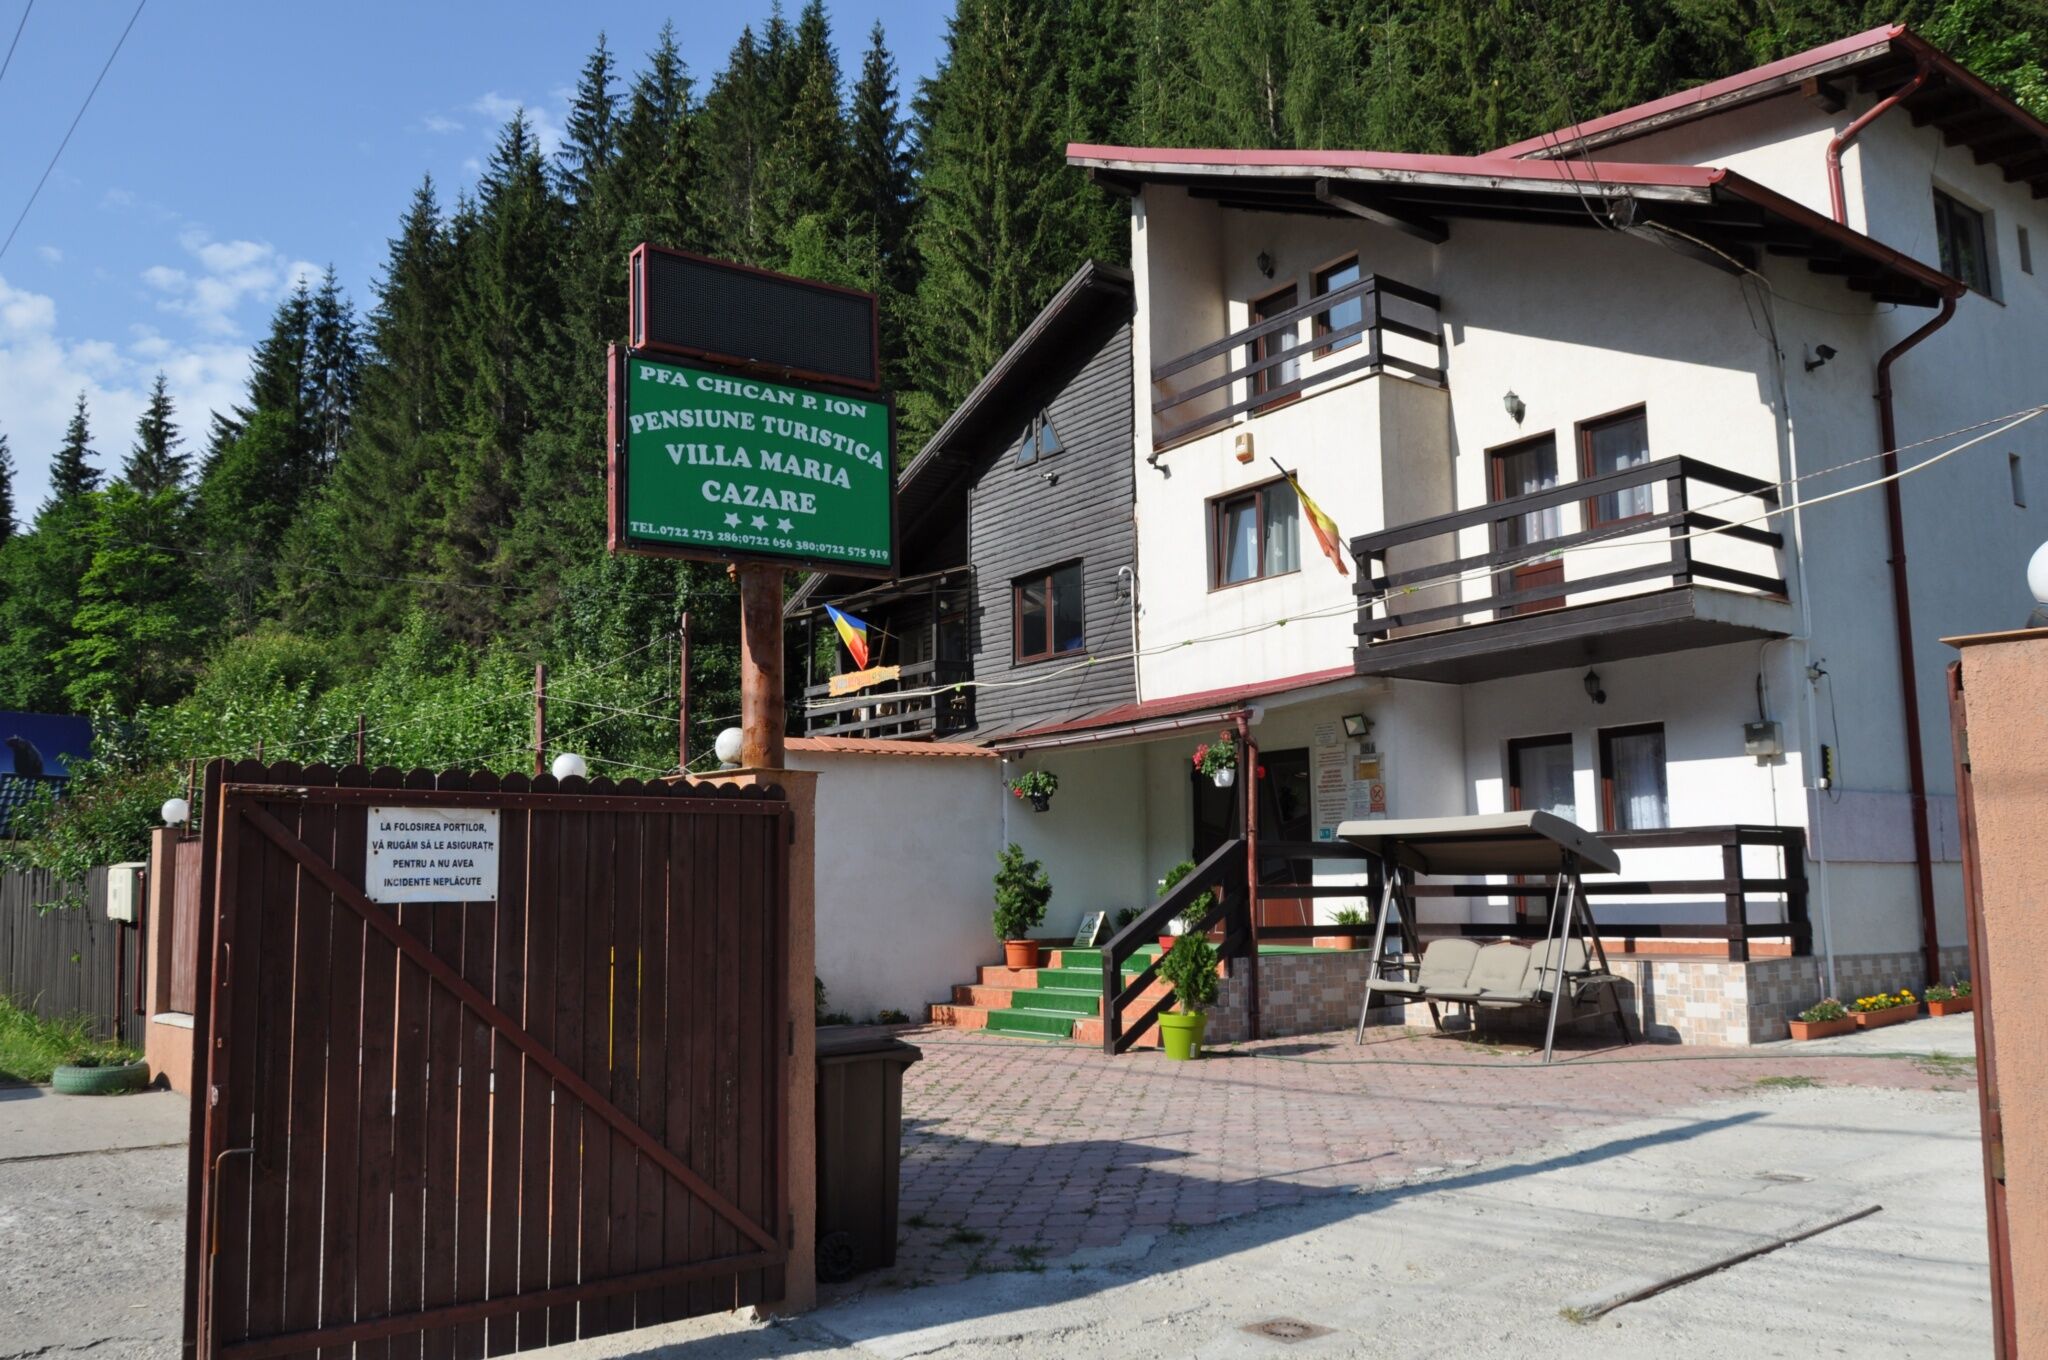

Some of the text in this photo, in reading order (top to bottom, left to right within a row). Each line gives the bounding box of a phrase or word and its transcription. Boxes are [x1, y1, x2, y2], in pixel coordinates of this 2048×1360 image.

[639, 366, 867, 418] PFA CHICAN P. ION
[629, 409, 884, 469] PENSIUNE TURISTICA
[666, 444, 851, 489] VILLA MARIA
[701, 480, 817, 515] CAZARE
[630, 521, 689, 537] TEL.0722
[692, 529, 714, 541] 273
[772, 537, 793, 548] 656
[847, 547, 867, 558] 575
[870, 549, 889, 560] 919
[372, 838, 385, 850] VĂ
[387, 838, 418, 850] RUGĂM
[420, 838, 432, 850] SĂ
[434, 841, 444, 850] LE
[380, 822, 391, 831] LA
[394, 822, 441, 831] FOLOSIREA
[393, 859, 474, 868] PENTRU A NU AVEA
[384, 876, 482, 887] INCIDENTE NEPLĂCUTE
